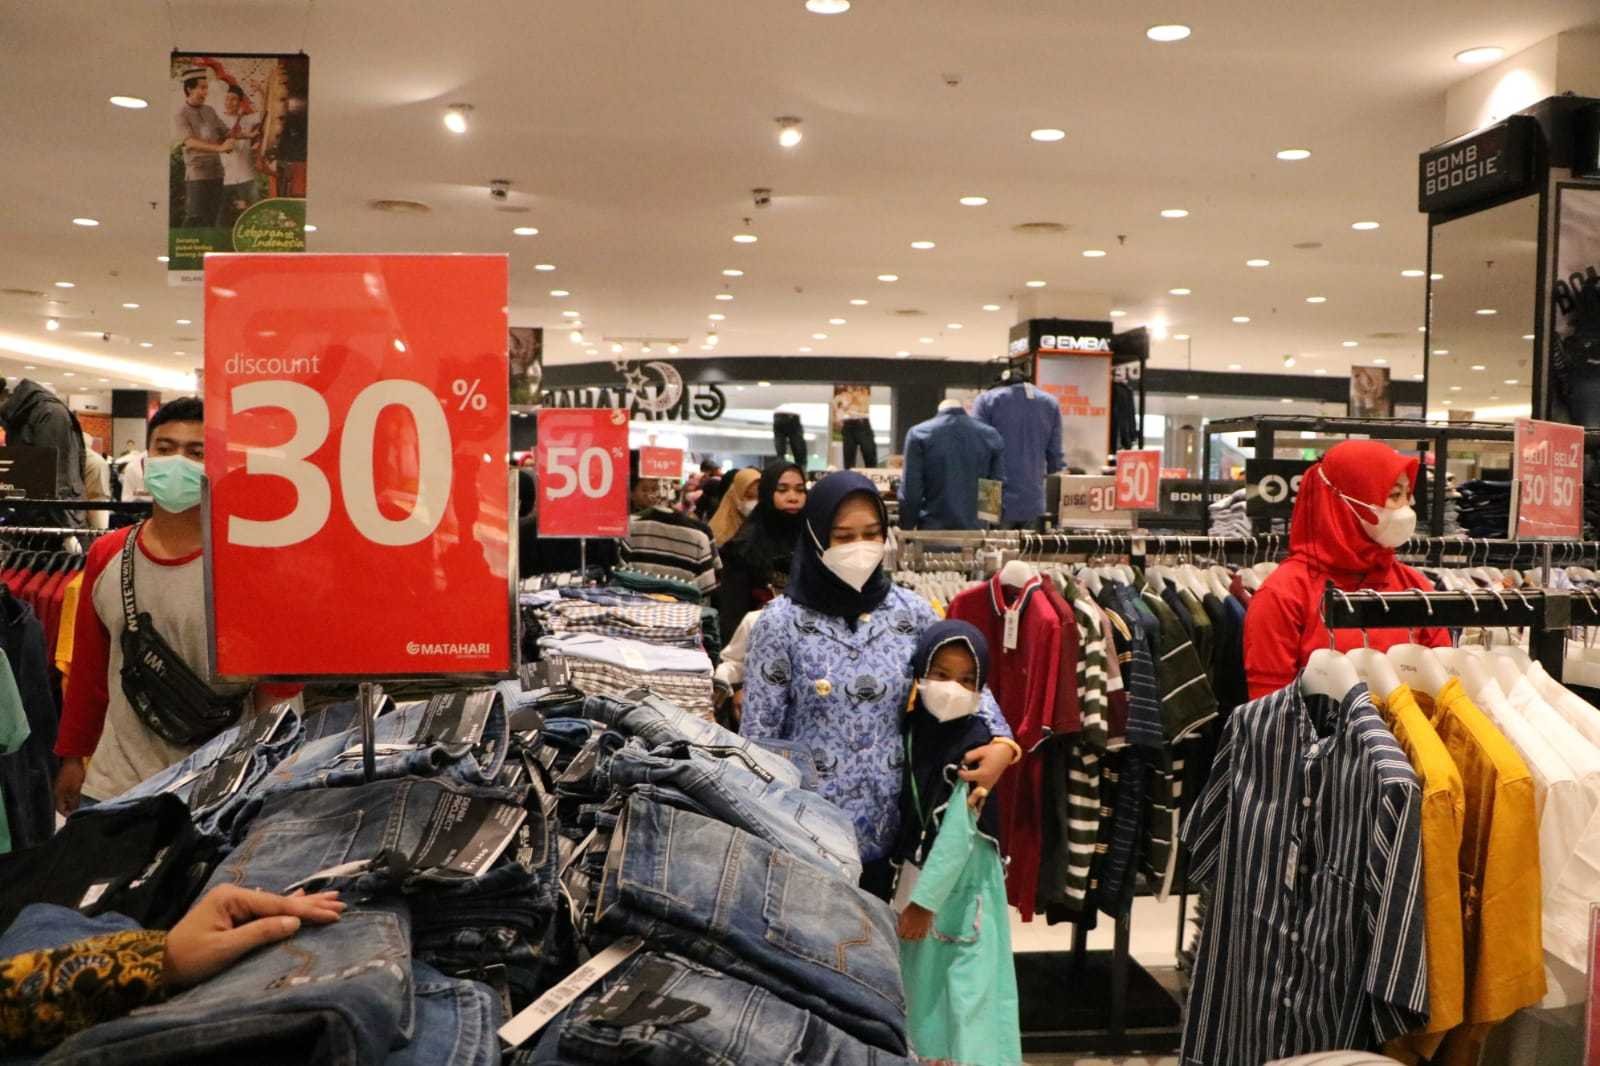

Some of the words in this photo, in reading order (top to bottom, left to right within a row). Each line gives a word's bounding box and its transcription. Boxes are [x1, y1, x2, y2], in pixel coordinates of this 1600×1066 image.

[1426, 145, 1477, 177] BOMB
[1426, 156, 1497, 196] BOOGIE
[1057, 335, 1110, 352] EMBA
[225, 353, 320, 375] discount
[1089, 487, 1116, 512] 30
[421, 642, 490, 655] MATAHARI
